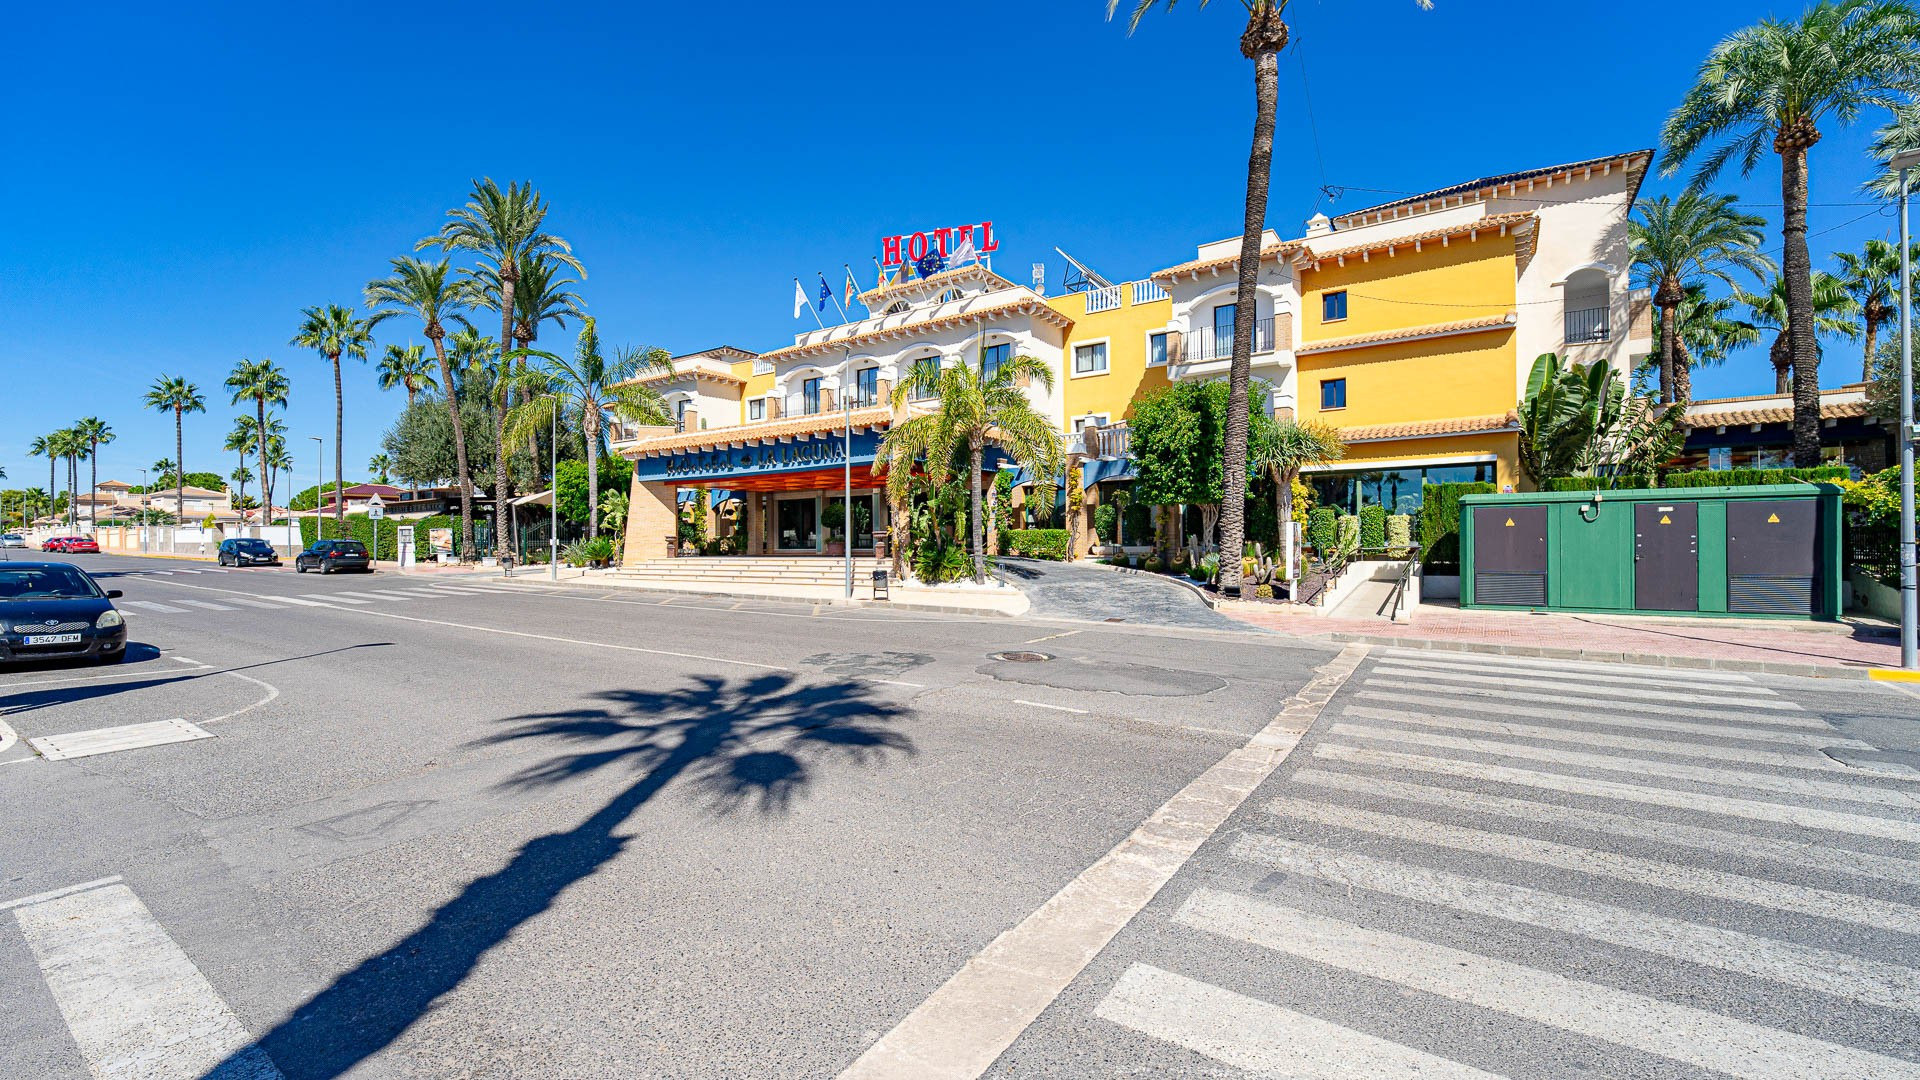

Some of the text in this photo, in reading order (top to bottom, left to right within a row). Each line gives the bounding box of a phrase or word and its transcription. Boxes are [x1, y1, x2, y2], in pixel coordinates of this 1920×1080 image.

[758, 449, 778, 466] LA
[782, 442, 846, 463] LAGUNA
[33, 636, 57, 644] 3547
